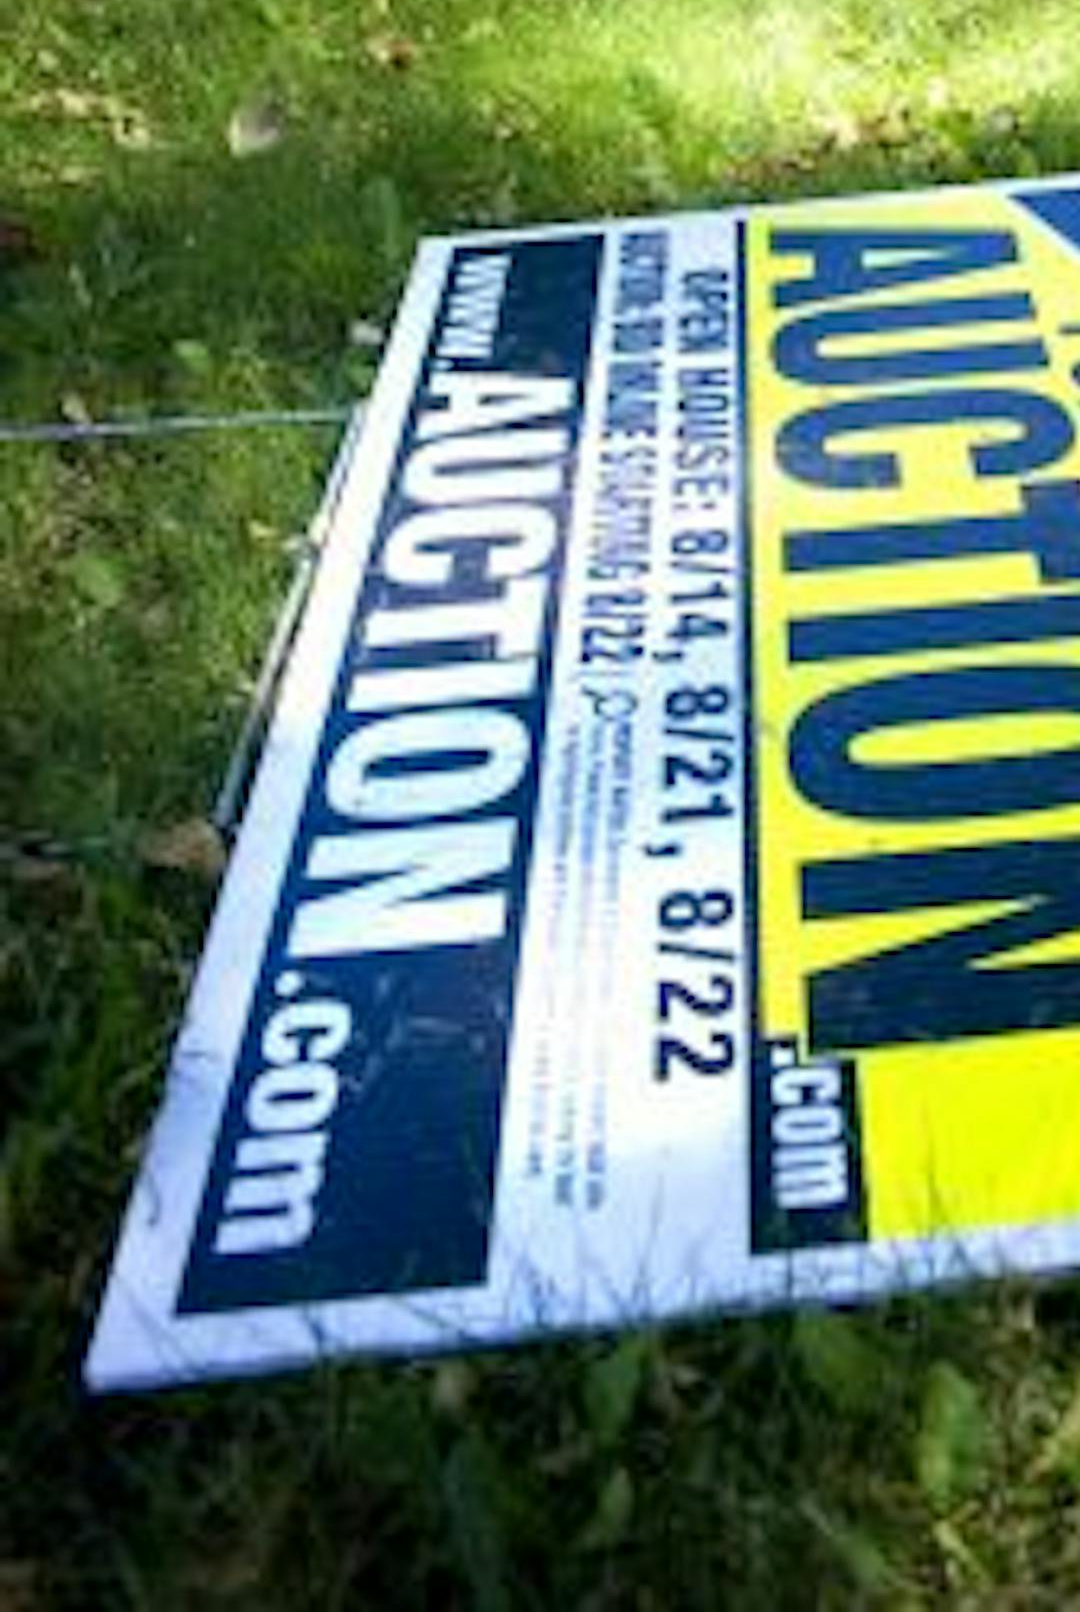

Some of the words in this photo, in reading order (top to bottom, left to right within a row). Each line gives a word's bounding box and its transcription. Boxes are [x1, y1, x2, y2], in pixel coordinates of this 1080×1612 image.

[677, 270, 729, 354] OPEN
[671, 367, 729, 510] HOUSE:
[585, 445, 658, 580] STARTING
[652, 528, 732, 662] 8/14,
[644, 686, 736, 859] 8/21,
[653, 889, 736, 1084] 8/22
